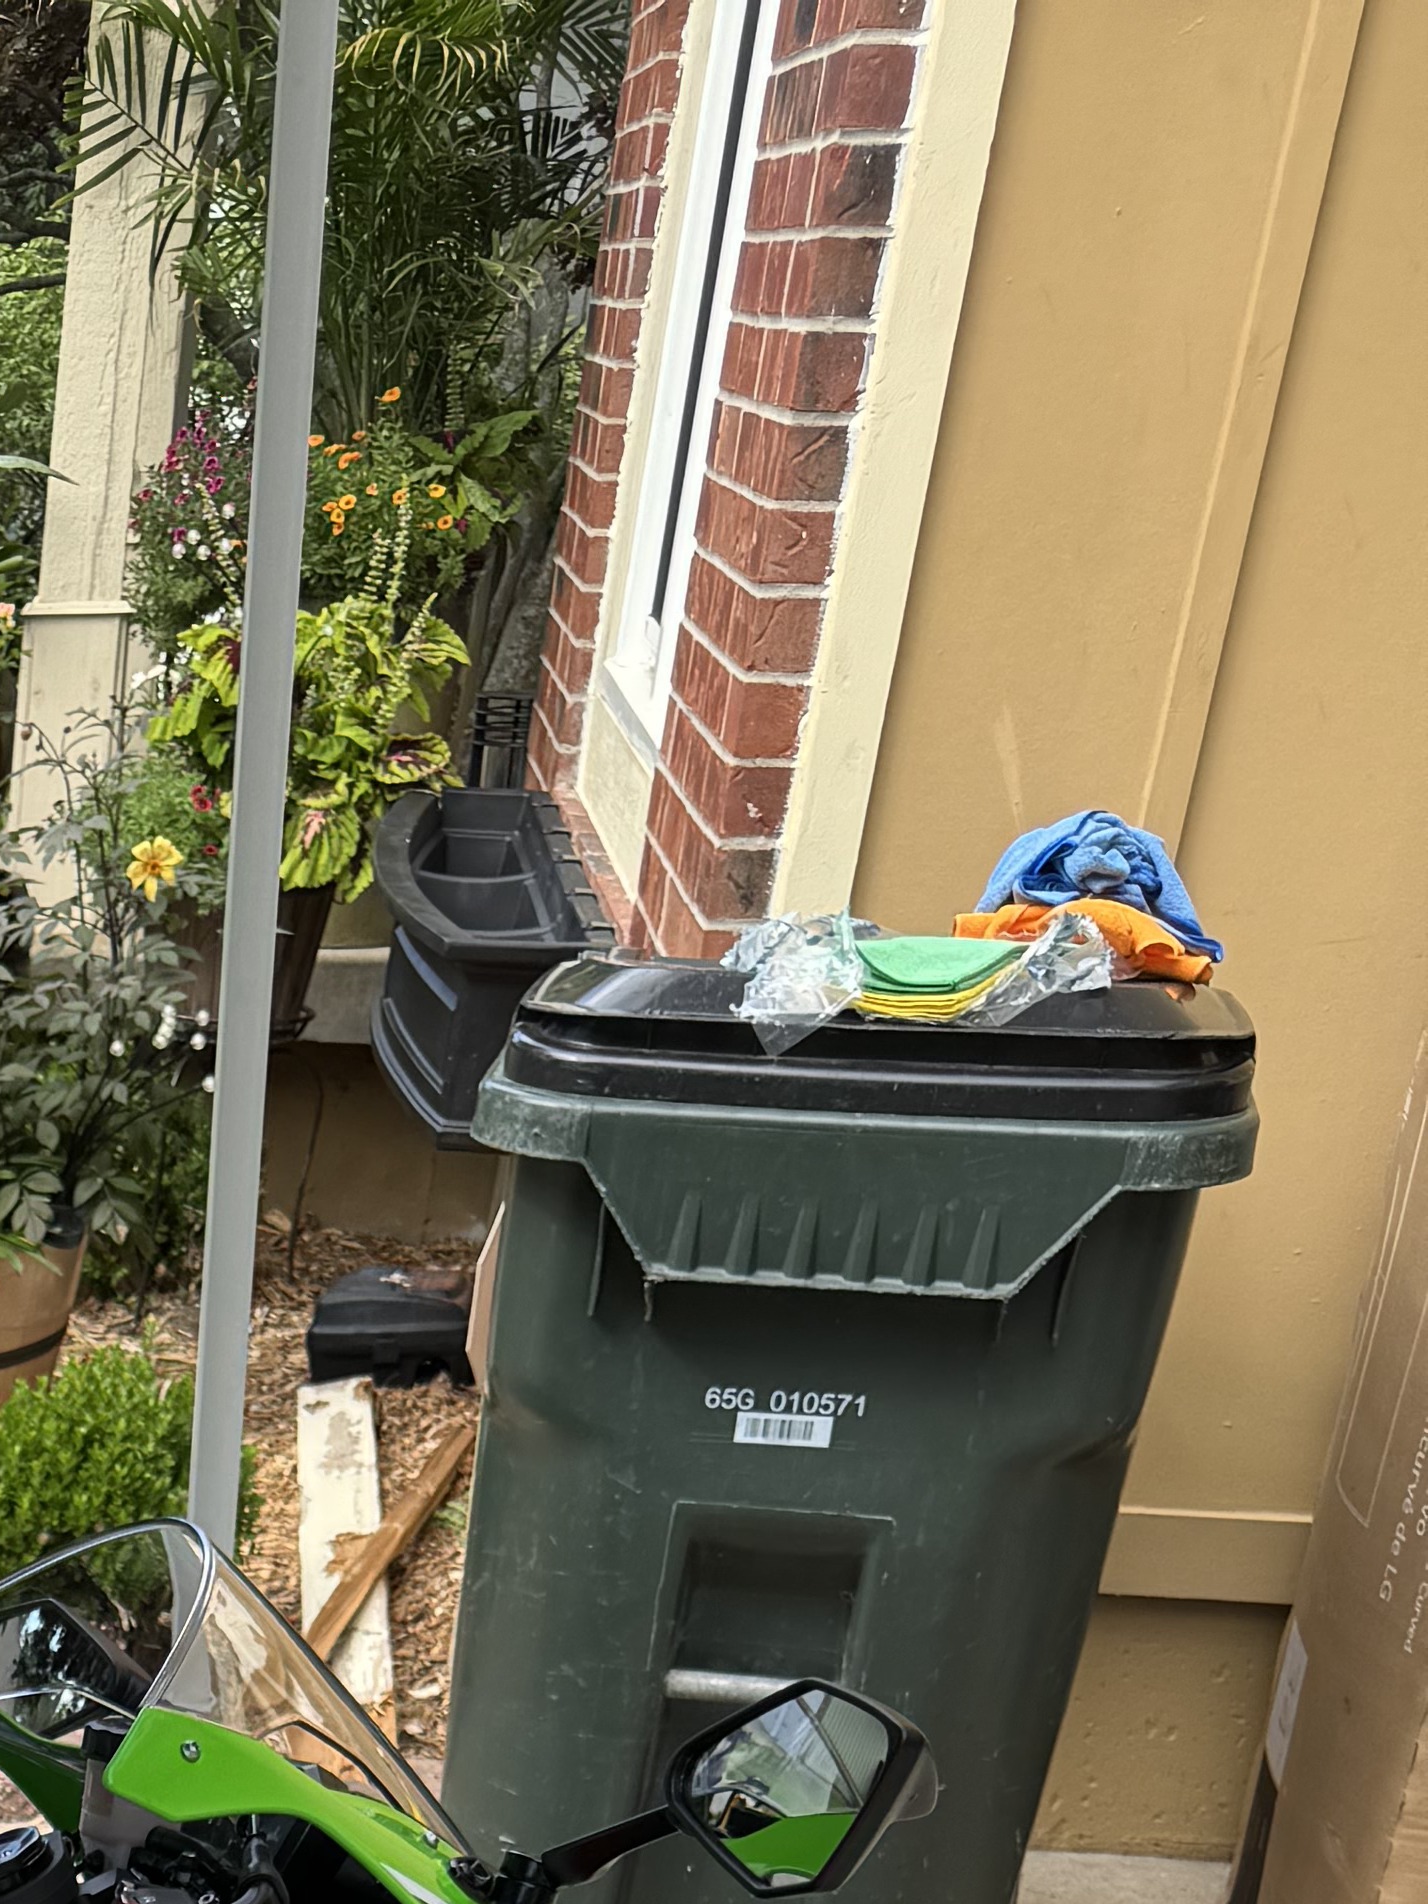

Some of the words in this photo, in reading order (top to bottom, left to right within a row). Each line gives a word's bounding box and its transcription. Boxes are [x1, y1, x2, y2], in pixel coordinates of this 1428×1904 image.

[704, 1386, 755, 1411] 65G
[769, 1390, 867, 1418] 010571
[1378, 1563, 1398, 1603] LG
